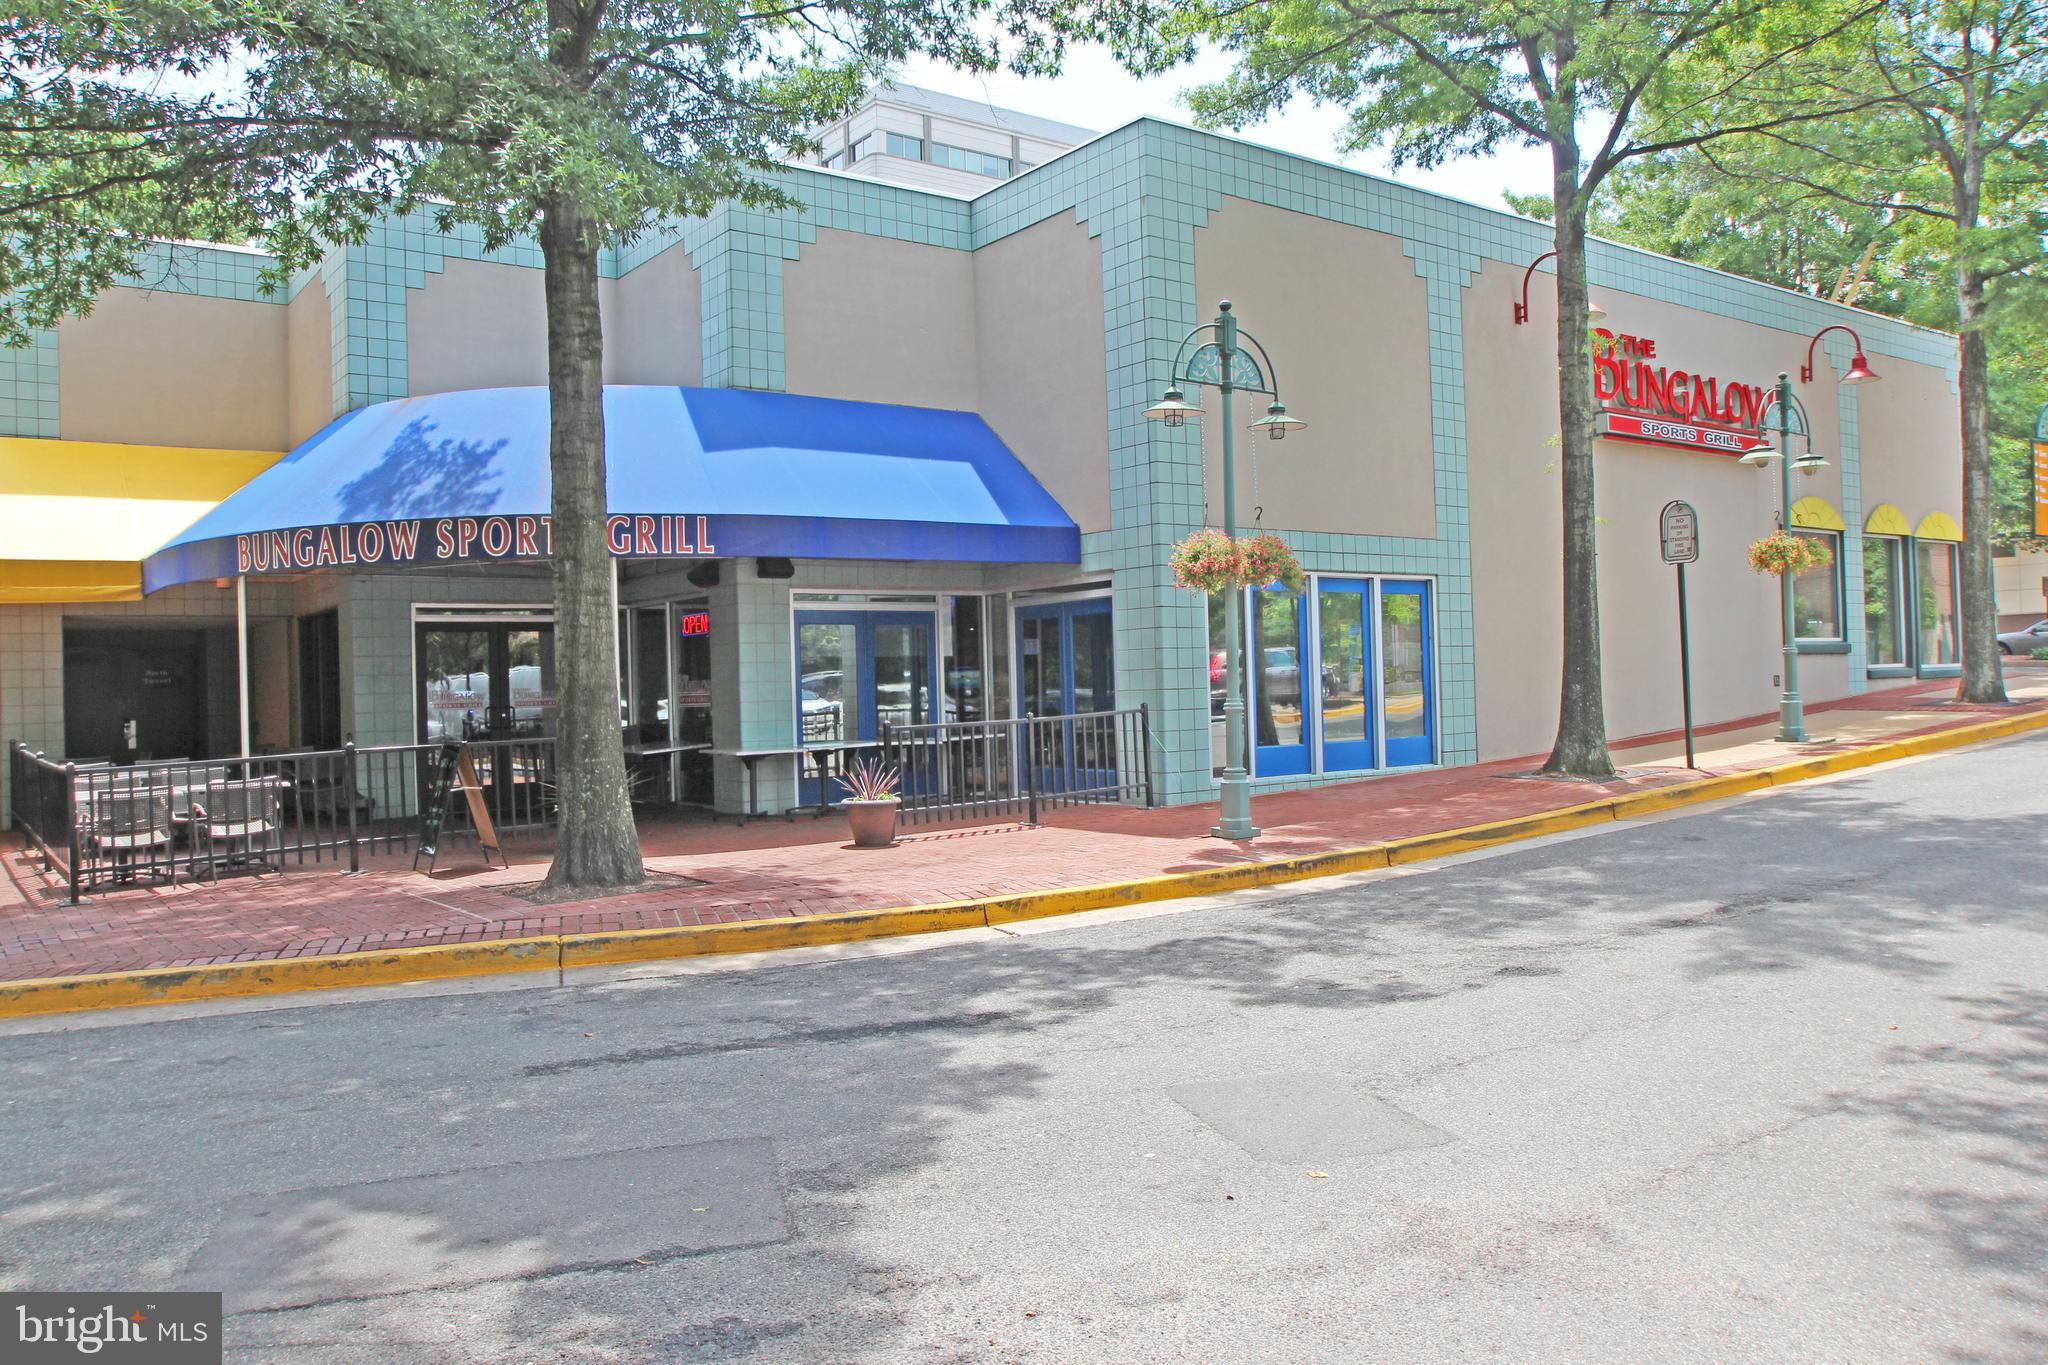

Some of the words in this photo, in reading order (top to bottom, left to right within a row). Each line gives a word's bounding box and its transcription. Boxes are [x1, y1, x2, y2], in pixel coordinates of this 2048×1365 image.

[1619, 334, 1657, 359] THE
[1641, 422, 1697, 442] SPORTS
[1704, 432, 1742, 449] GRILL
[237, 520, 421, 573] BUNGALOW
[436, 515, 553, 559] SPORT
[607, 514, 715, 555] GRILL
[683, 613, 709, 635] OPEN
